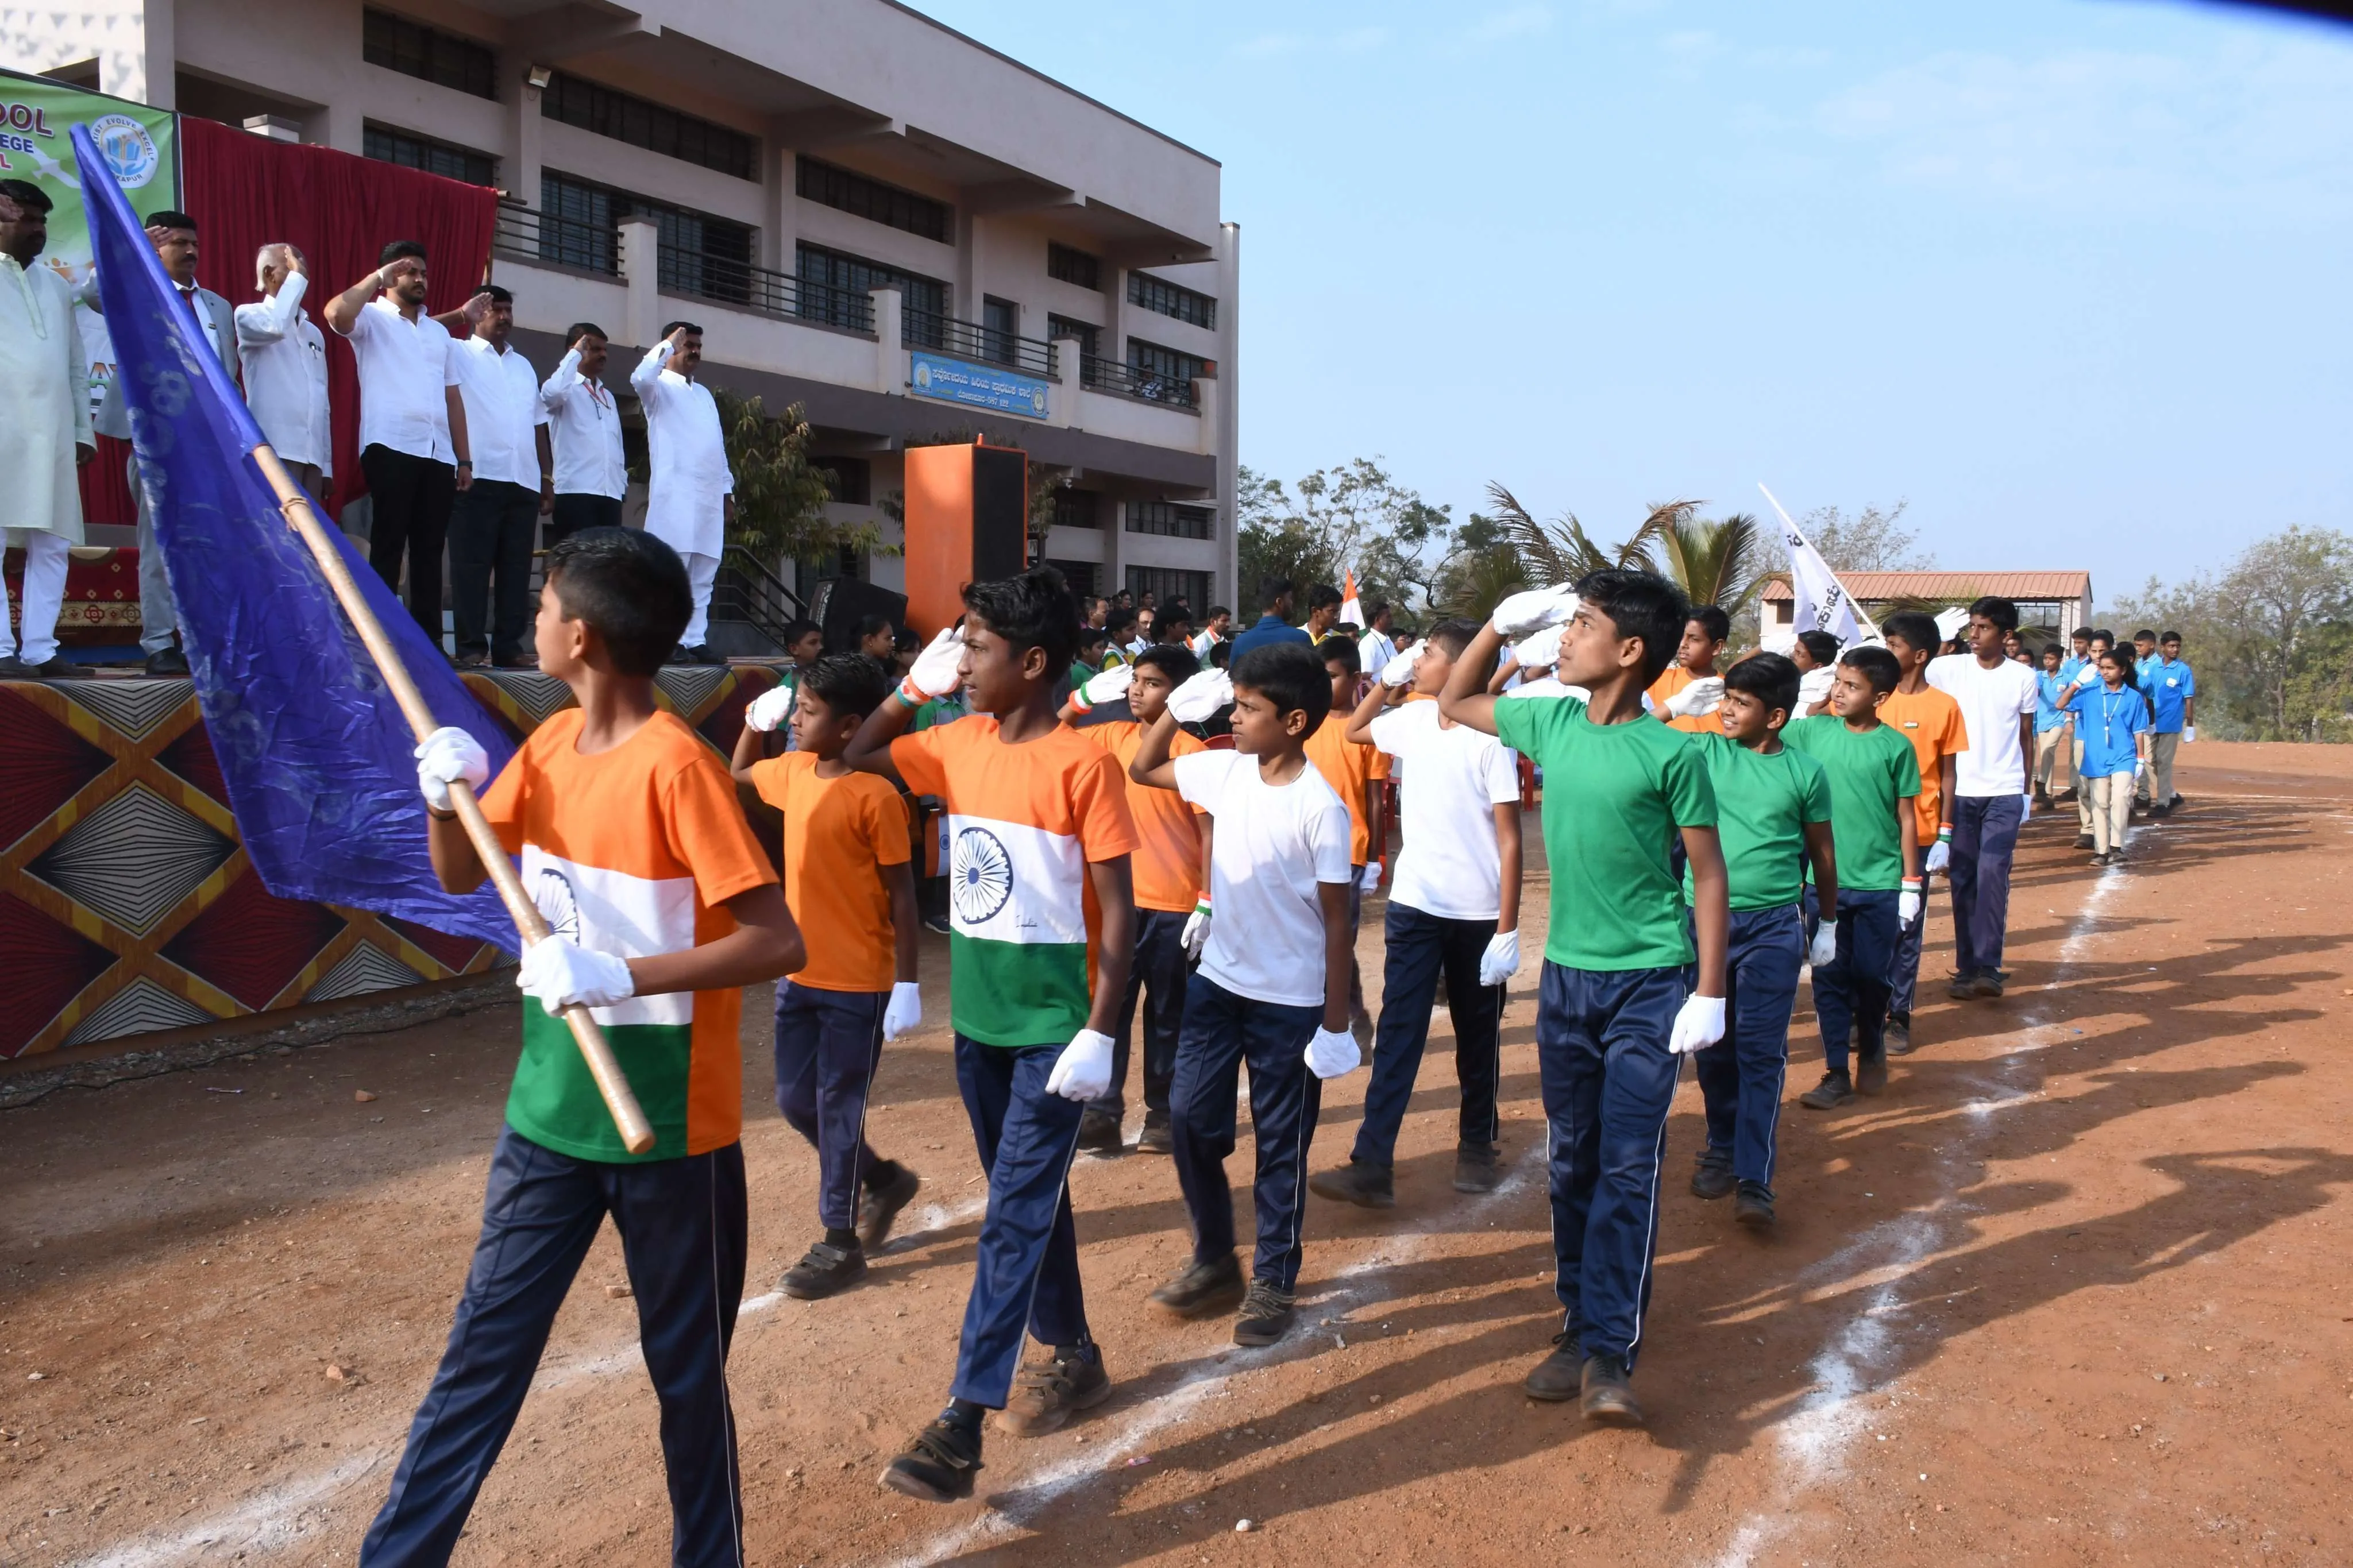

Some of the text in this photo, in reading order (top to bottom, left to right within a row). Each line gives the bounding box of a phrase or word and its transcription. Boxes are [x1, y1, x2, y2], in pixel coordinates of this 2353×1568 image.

[0, 102, 54, 137] OL
[106, 118, 136, 128] EVOLVE
[115, 174, 142, 182] KAPUR
